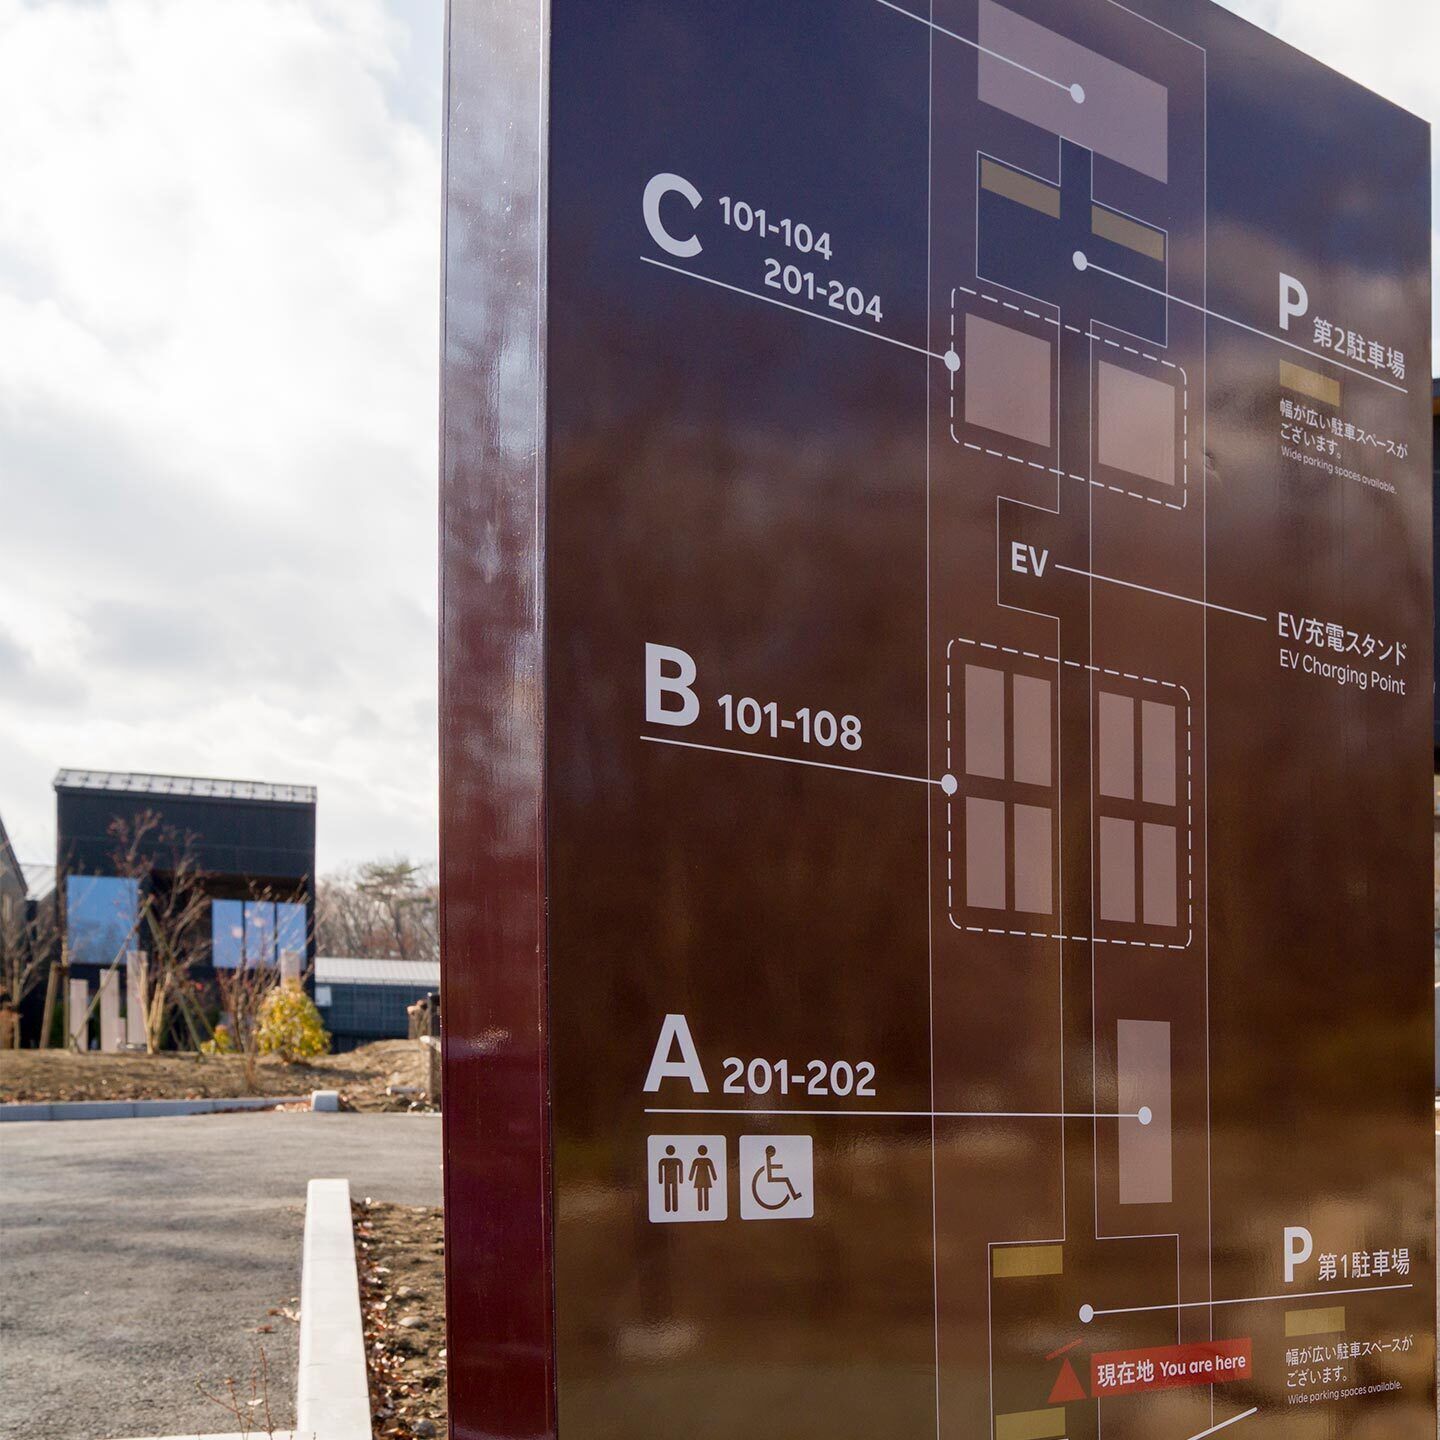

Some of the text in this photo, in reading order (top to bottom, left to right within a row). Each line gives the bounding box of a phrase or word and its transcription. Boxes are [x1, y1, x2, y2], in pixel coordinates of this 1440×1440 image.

[643, 173, 833, 261] C 101-104
[764, 258, 883, 323] 201-204
[1279, 272, 1405, 380] P 第2駐車場
[1279, 398, 1409, 459] 幅が広い駐車スペースが
[1280, 423, 1342, 460] ございます。
[1281, 445, 1398, 495] Wide parking spaces available.
[1012, 541, 1048, 578] EV
[1278, 612, 1408, 667] EV充電スタンド
[645, 642, 863, 751] B 101-108
[1280, 648, 1406, 696] EV Charging Point
[643, 1013, 876, 1097] A 201-202
[1284, 1226, 1410, 1283] P 第1駐車場
[1097, 1355, 1246, 1388] 現在地 You are here
[1285, 1334, 1414, 1367] 幅が広い駐車スペースが
[1286, 1365, 1348, 1388] ございます。
[1288, 1380, 1403, 1405] Wide parking spaces available.
